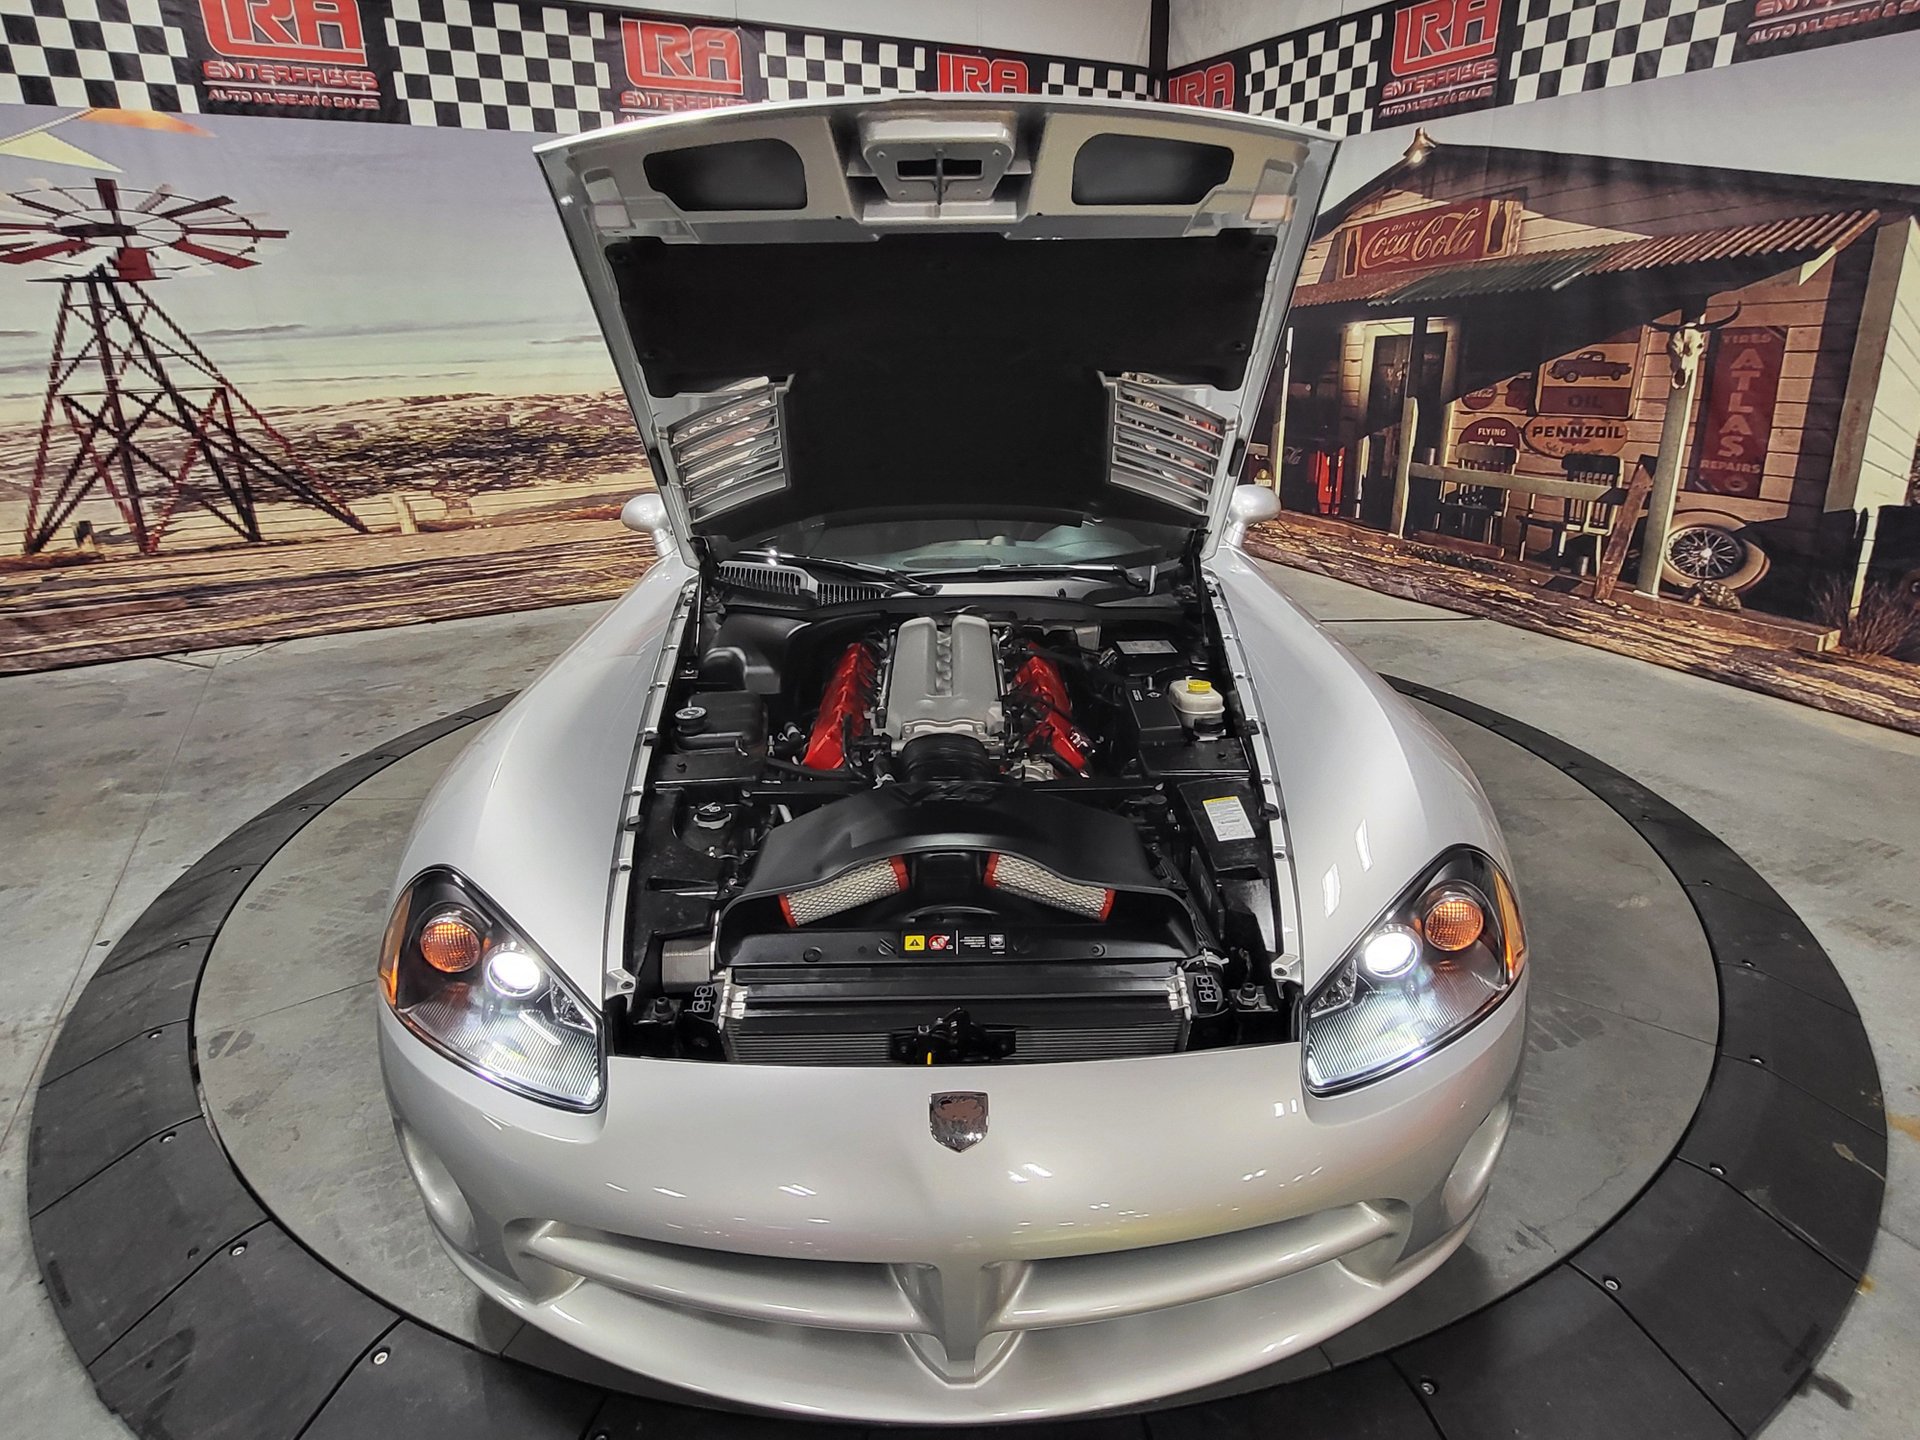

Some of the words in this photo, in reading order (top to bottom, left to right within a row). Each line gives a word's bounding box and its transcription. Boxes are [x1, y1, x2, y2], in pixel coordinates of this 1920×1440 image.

[1747, 23, 1796, 45] AUTO
[203, 60, 378, 91] ENTERPRISES
[937, 51, 1028, 93] IRA
[1382, 58, 1498, 99] ENTERPRISES
[208, 88, 252, 102] AUTO
[1721, 334, 1772, 344] TIRES
[1718, 347, 1764, 457] ATLAS
[1477, 427, 1507, 437] FLYING
[1532, 424, 1625, 440] PENNZOIL
[1700, 459, 1761, 474] REPAIRS
